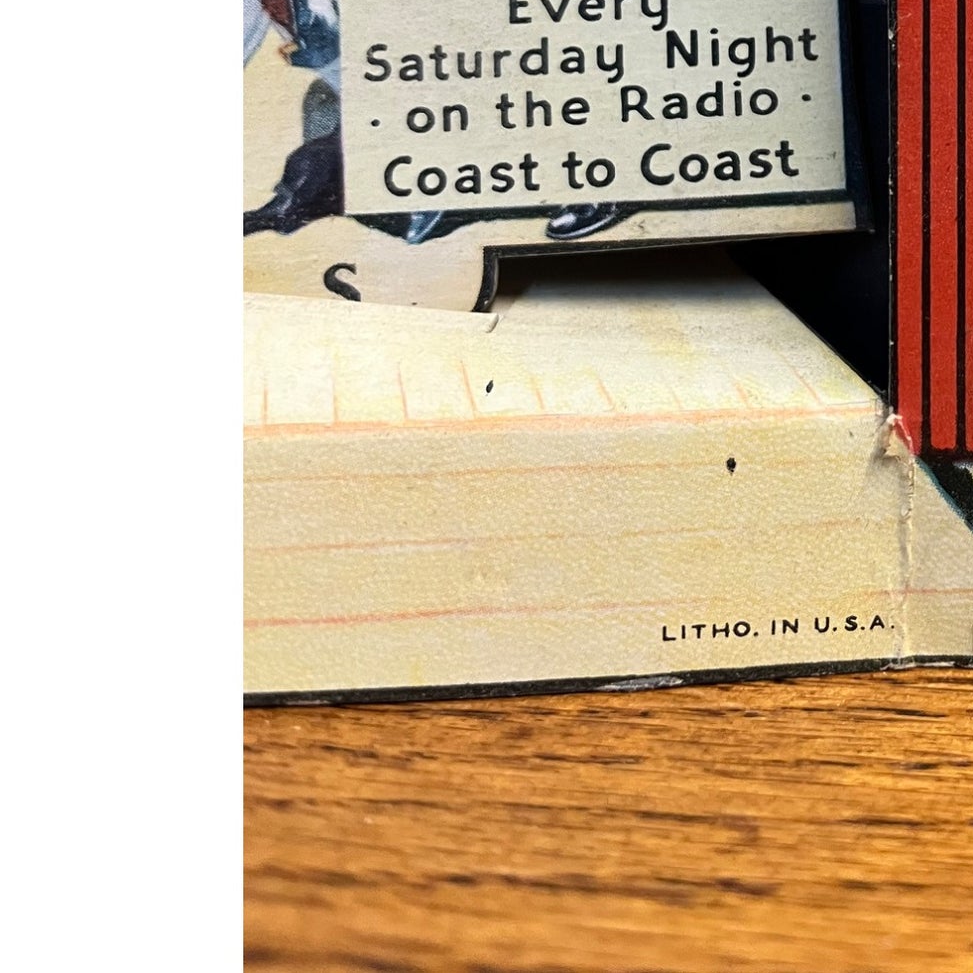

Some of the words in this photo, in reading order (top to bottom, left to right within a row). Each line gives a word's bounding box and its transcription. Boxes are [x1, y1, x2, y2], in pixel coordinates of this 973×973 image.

[364, 36, 625, 84] Saturday
[665, 26, 820, 78] Night
[405, 104, 469, 134] on
[495, 90, 591, 130] the
[620, 80, 780, 123] Radio
[383, 153, 541, 197] Coast
[561, 151, 617, 190] to
[640, 140, 801, 186] Coast
[661, 620, 760, 642] LITHO.
[770, 618, 799, 635] IN
[814, 614, 896, 633] U.S.A.
